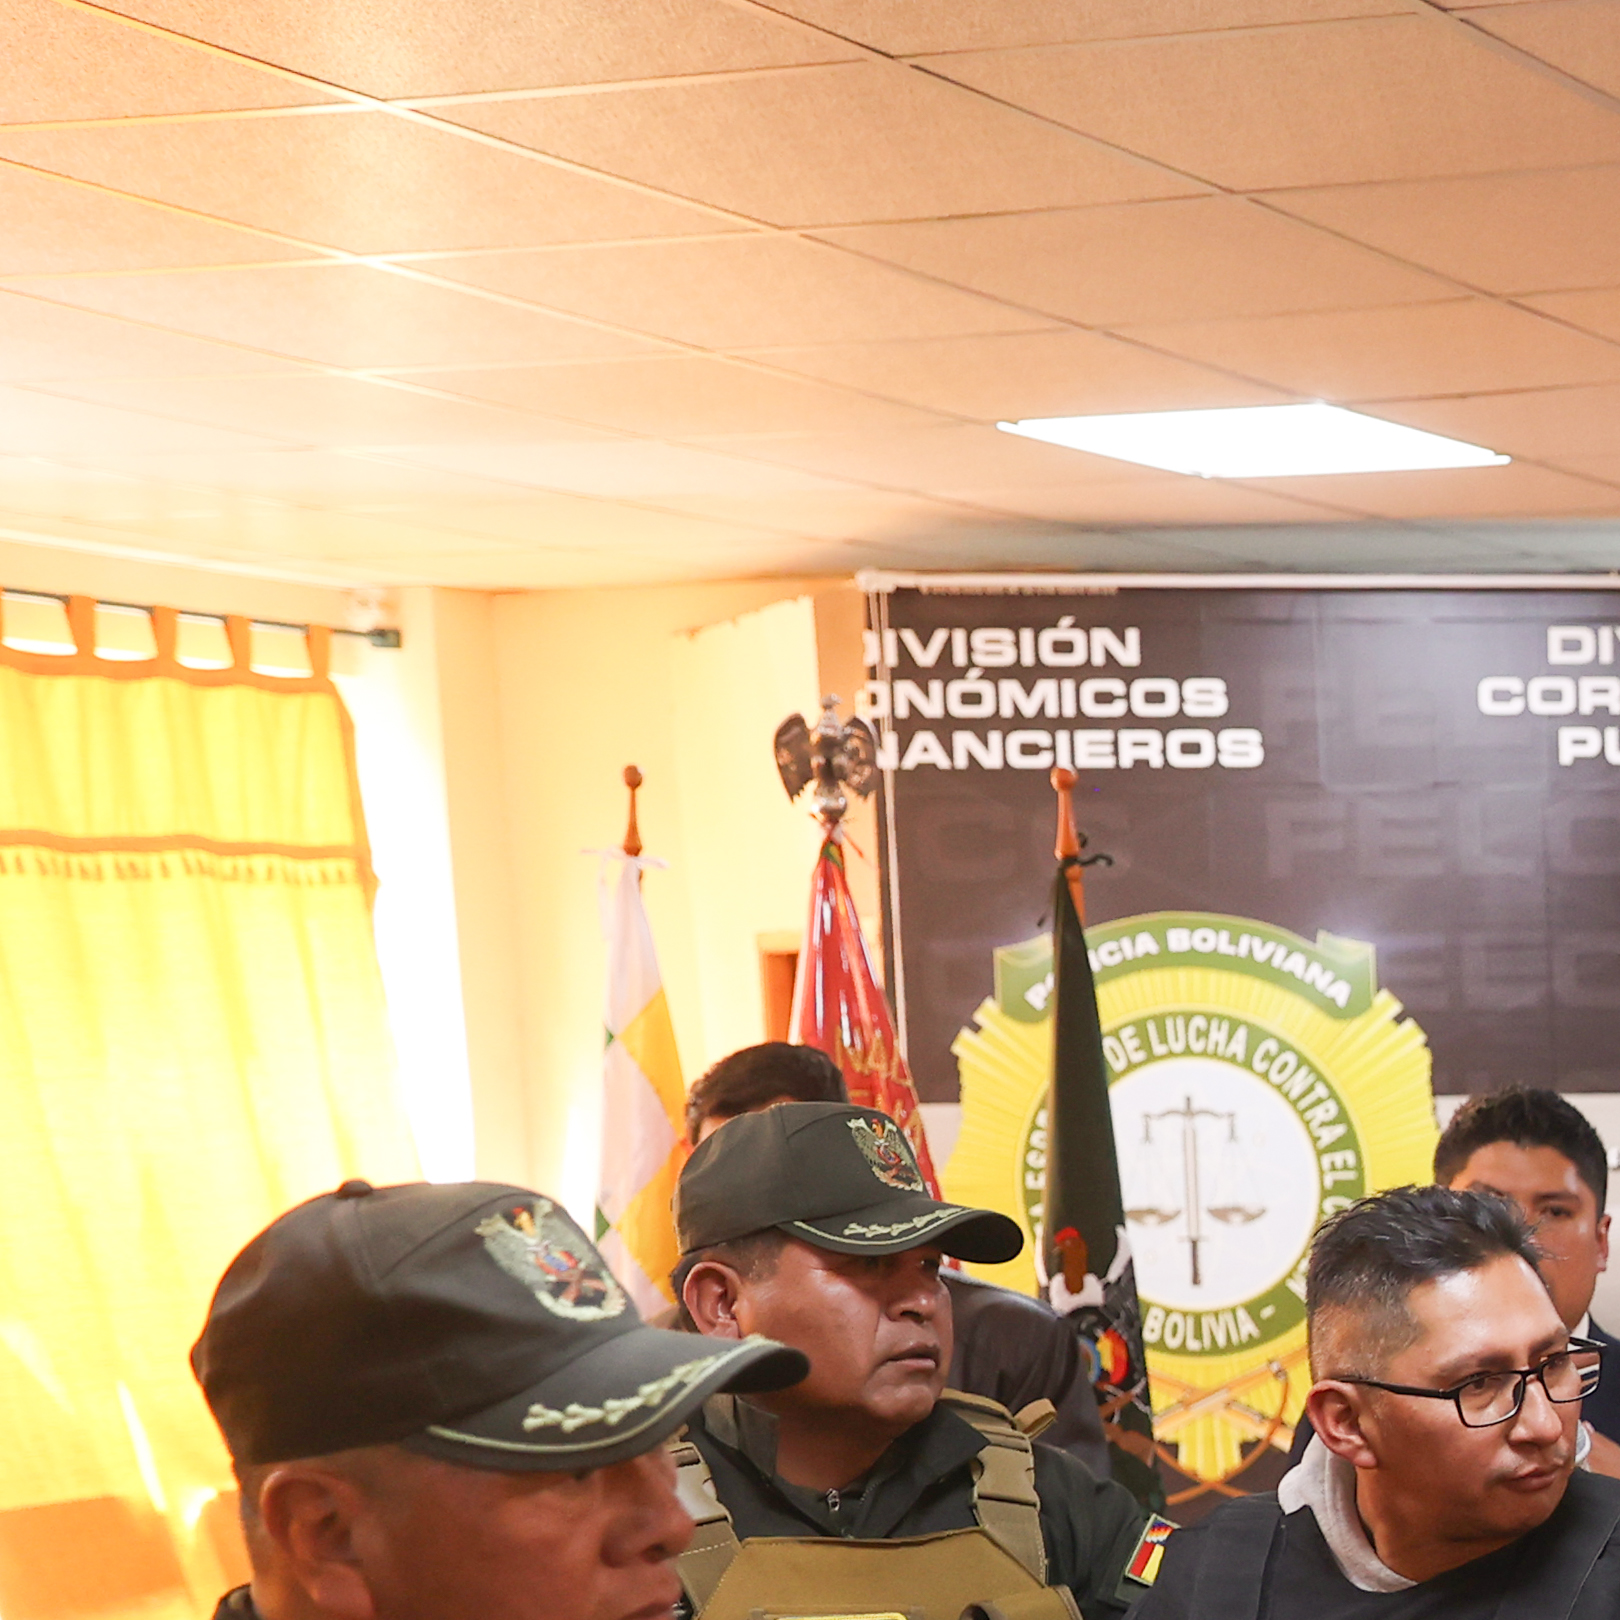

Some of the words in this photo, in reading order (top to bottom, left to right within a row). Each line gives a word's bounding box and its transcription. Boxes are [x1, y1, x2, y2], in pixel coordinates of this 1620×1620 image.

[1024, 931, 1160, 1012] PICIA
[1167, 926, 1352, 1009] BOLIVIANA
[1106, 1026, 1147, 1073] DE
[1151, 1012, 1248, 1063] LUCHA
[1250, 1038, 1347, 1149] CONTRA
[1320, 1149, 1358, 1190] EL
[1143, 1304, 1261, 1352] BOLIVIA
